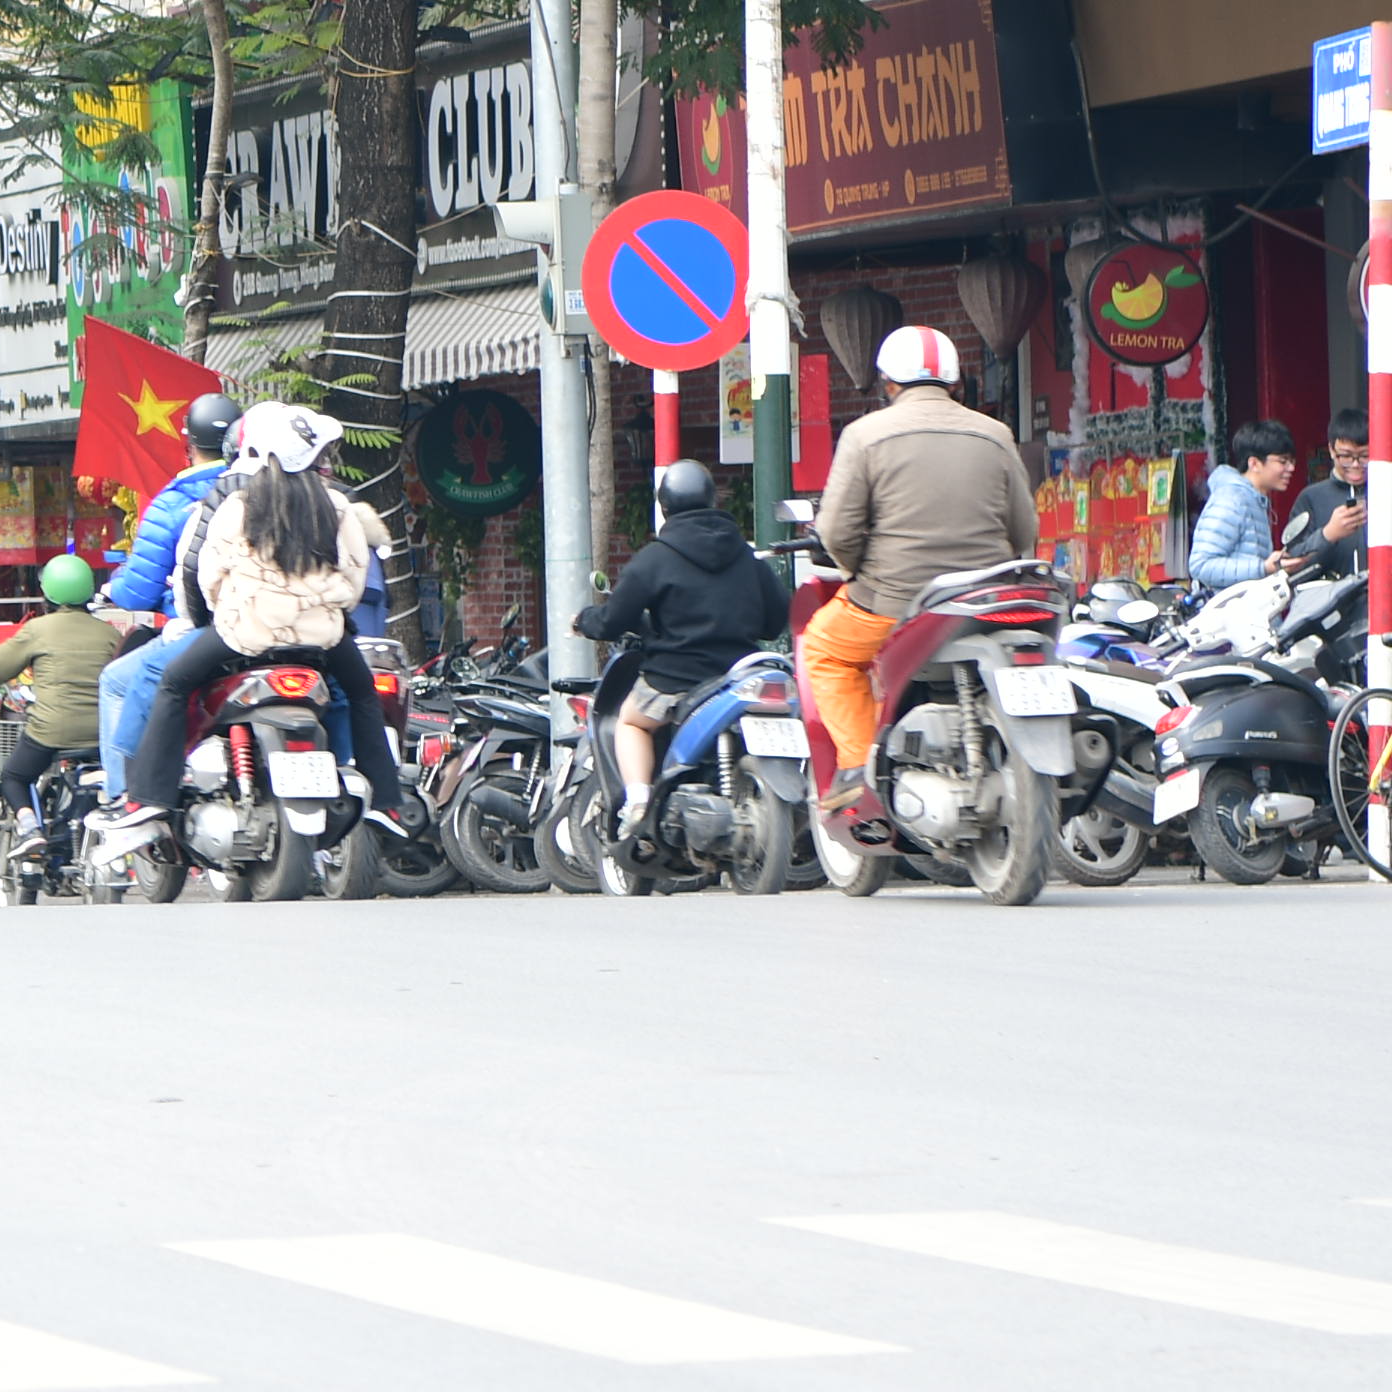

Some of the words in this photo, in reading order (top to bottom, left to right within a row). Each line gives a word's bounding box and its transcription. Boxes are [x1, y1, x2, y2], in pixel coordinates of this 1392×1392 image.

[427, 58, 535, 218] CLUB
[876, 40, 982, 148] CHANH
[1109, 332, 1158, 349] LEMON
[1159, 335, 1186, 351] TRA
